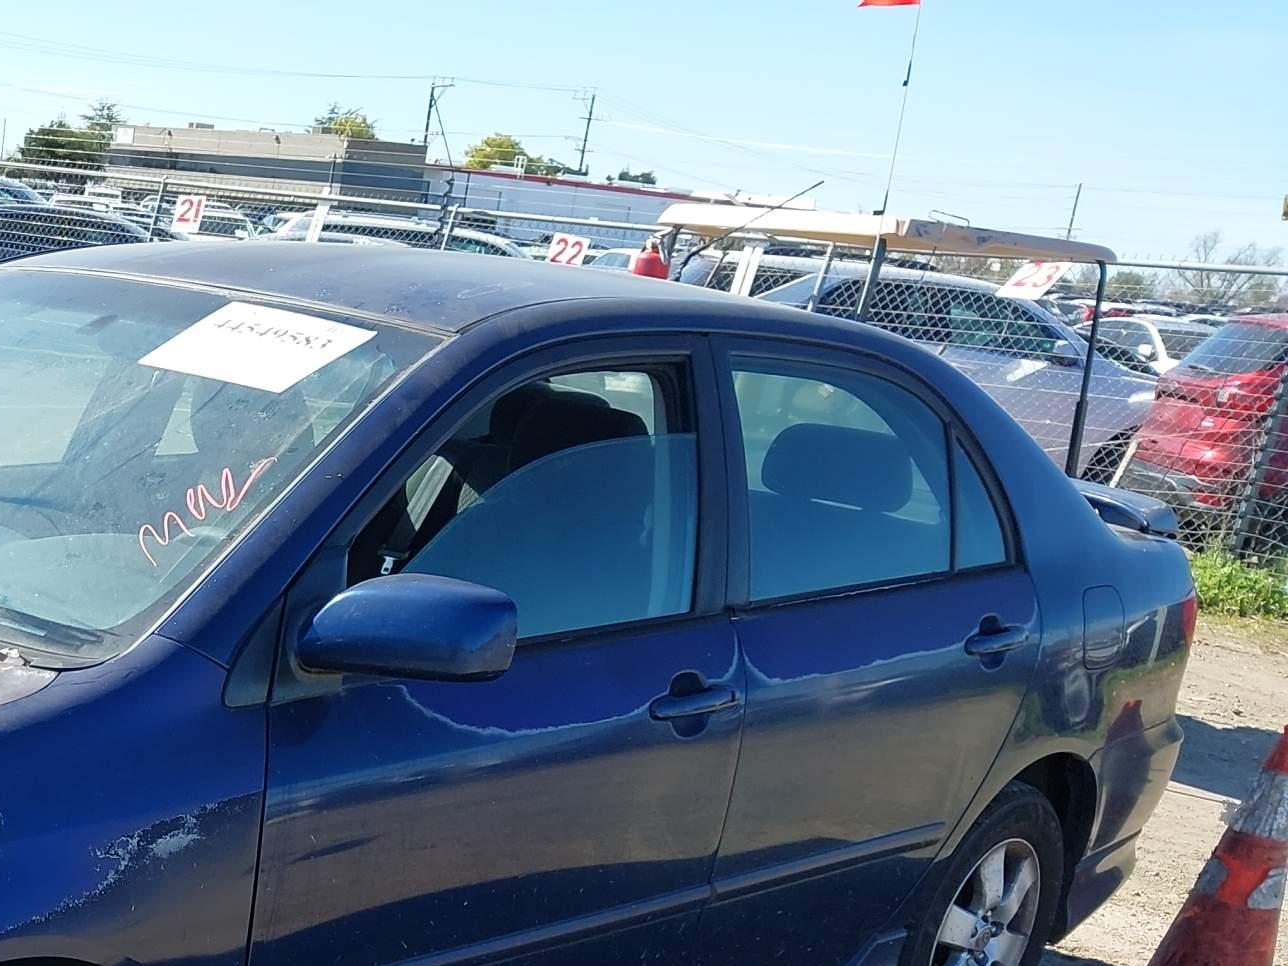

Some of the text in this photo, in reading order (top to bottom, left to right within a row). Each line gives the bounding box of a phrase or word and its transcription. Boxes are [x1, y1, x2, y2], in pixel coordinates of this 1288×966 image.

[175, 198, 203, 223] 21
[550, 237, 583, 266] 22
[1011, 260, 1061, 288] 23
